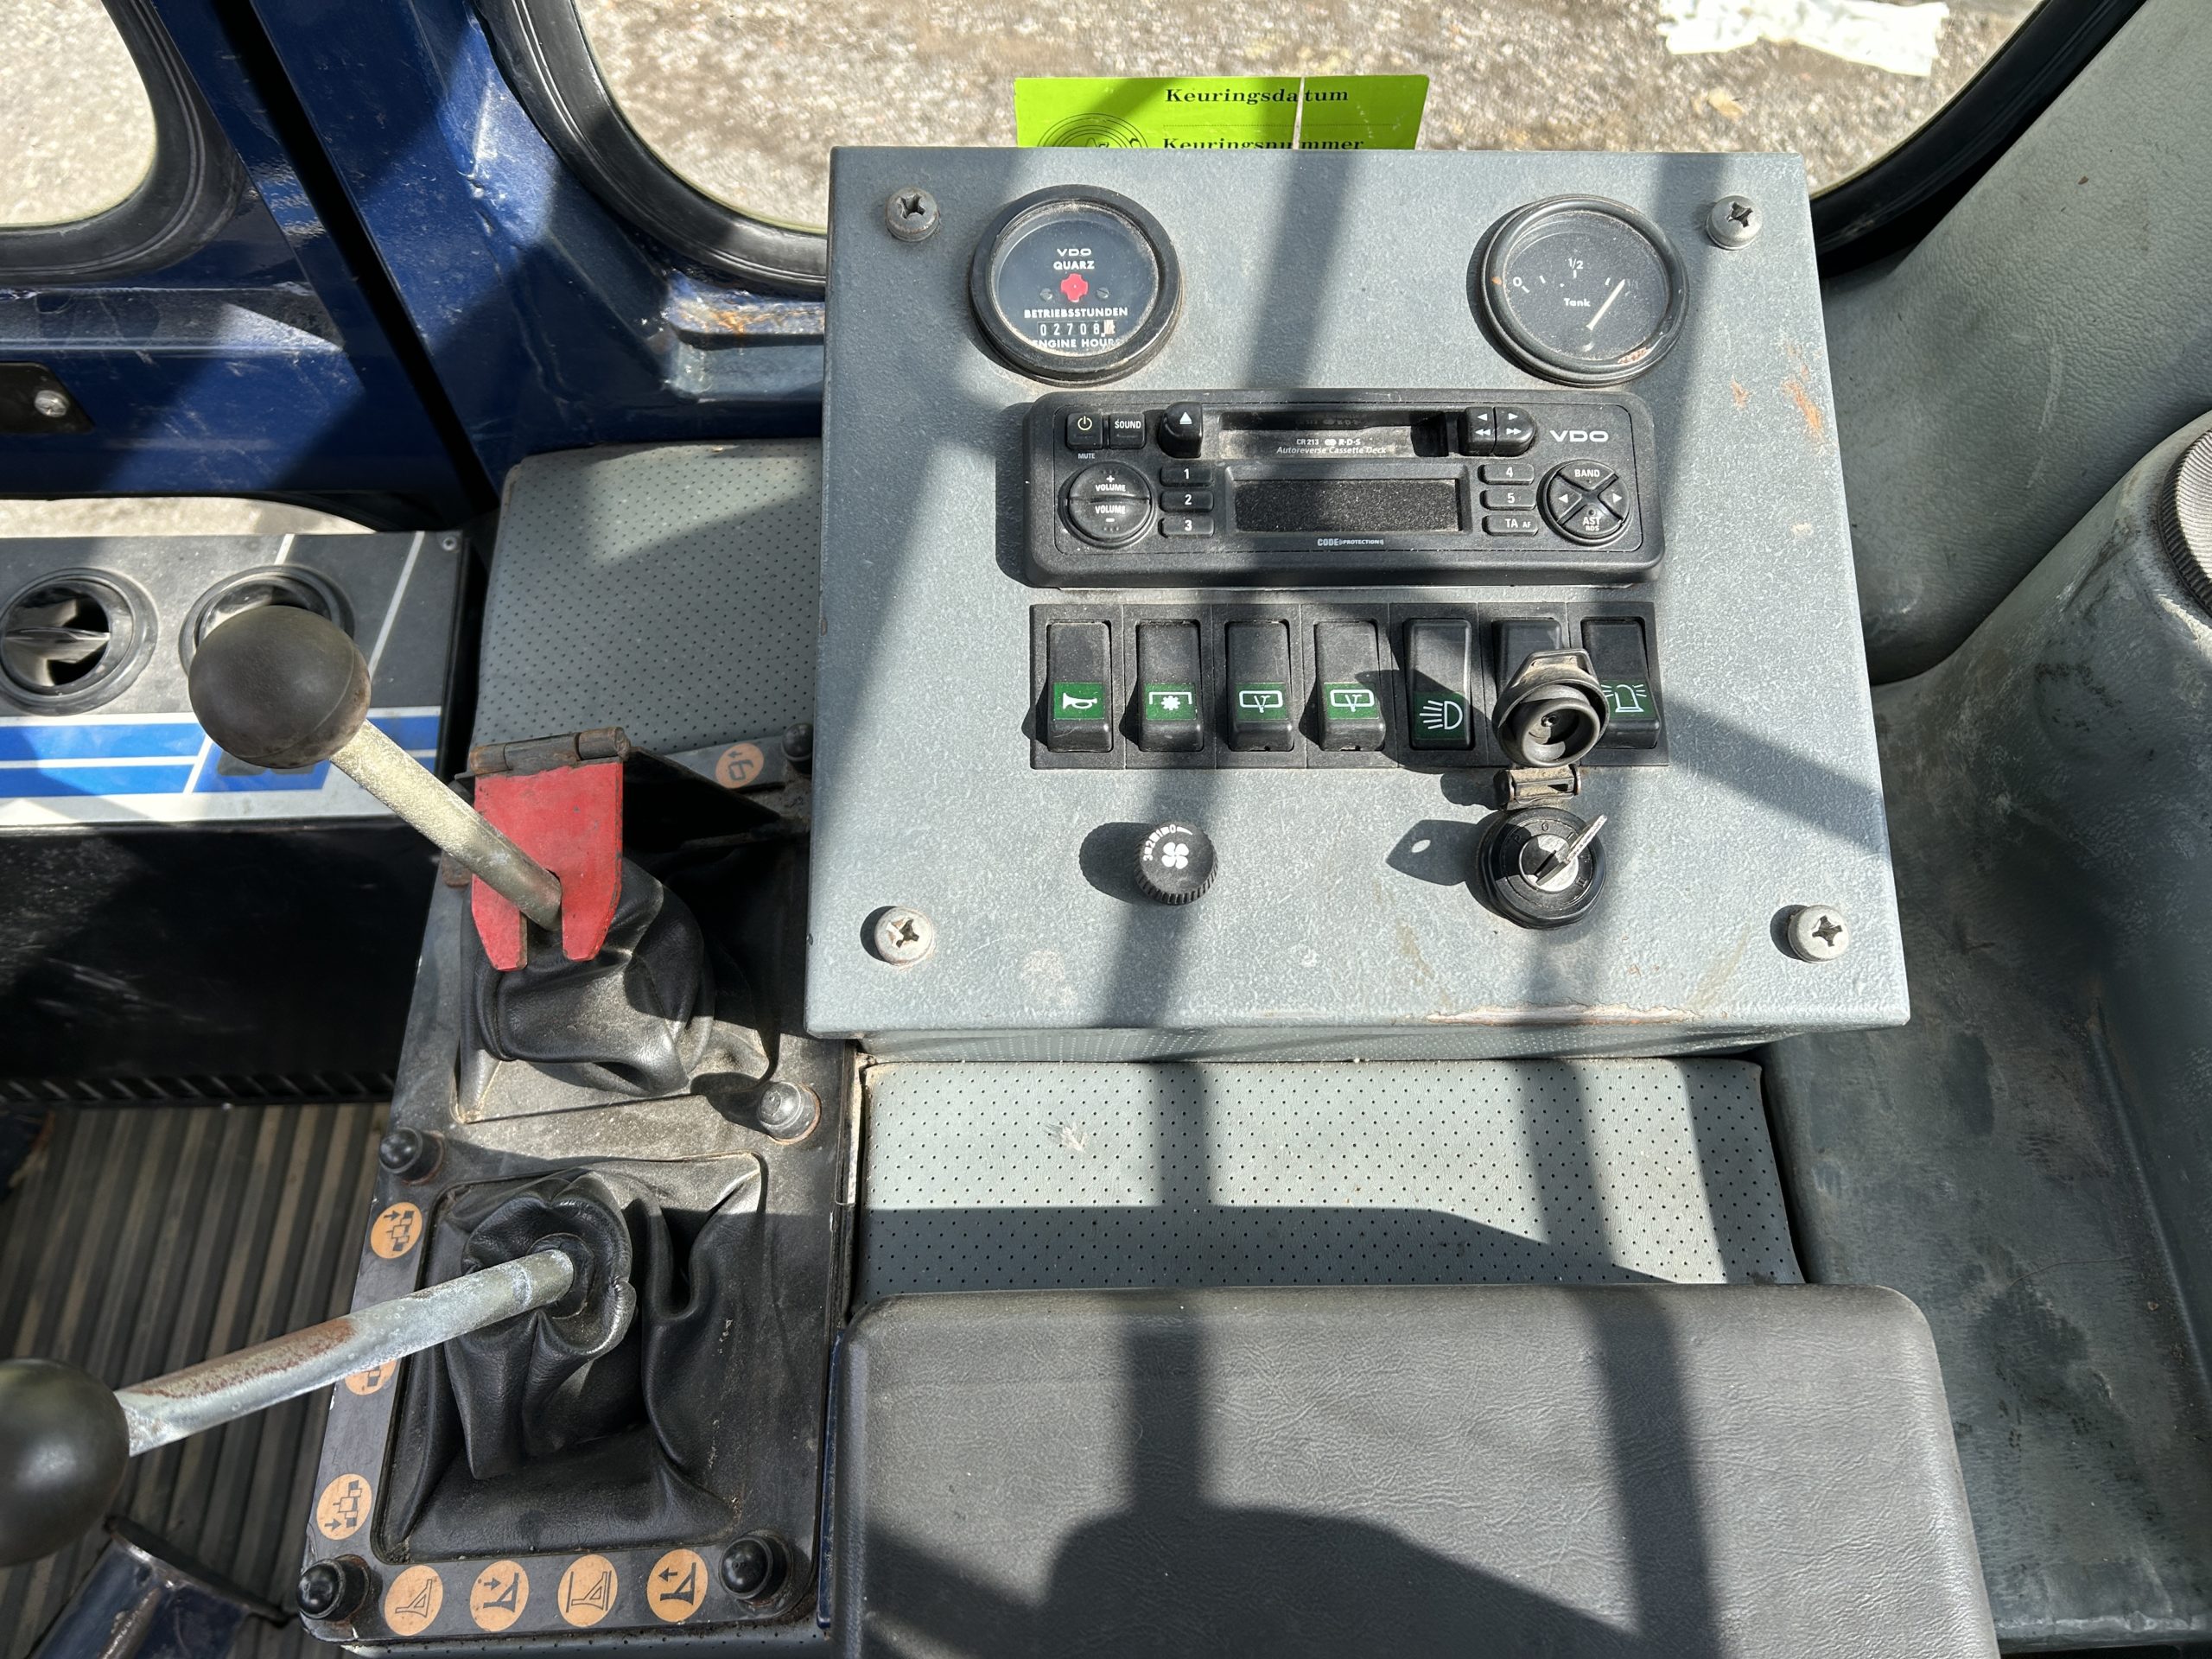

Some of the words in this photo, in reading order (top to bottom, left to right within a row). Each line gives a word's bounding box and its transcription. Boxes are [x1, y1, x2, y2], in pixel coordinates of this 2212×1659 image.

[1166, 88, 1349, 105] Keuringsdatum
[1057, 248, 1091, 257] VDO
[1053, 260, 1096, 270] QUARZ
[1568, 258, 1584, 270] 1/2
[1564, 297, 1591, 308] Tank
[1024, 307, 1128, 319] BETRIEBSSTUNDEN
[1114, 419, 1141, 429] SOUND
[1549, 429, 1609, 442] VDO
[1276, 446, 1327, 454] Autoreverse
[1328, 446, 1363, 454] Cassette
[1365, 446, 1387, 454] Deck
[1184, 468, 1190, 480] 1
[1505, 467, 1514, 478] 4
[1095, 483, 1127, 492] VOLUME
[1185, 494, 1192, 505] 2
[1507, 492, 1516, 504] 5
[1094, 505, 1127, 514] VOLUME
[1185, 520, 1192, 531] 3
[1504, 518, 1519, 528] TA
[1582, 516, 1601, 525] AST
